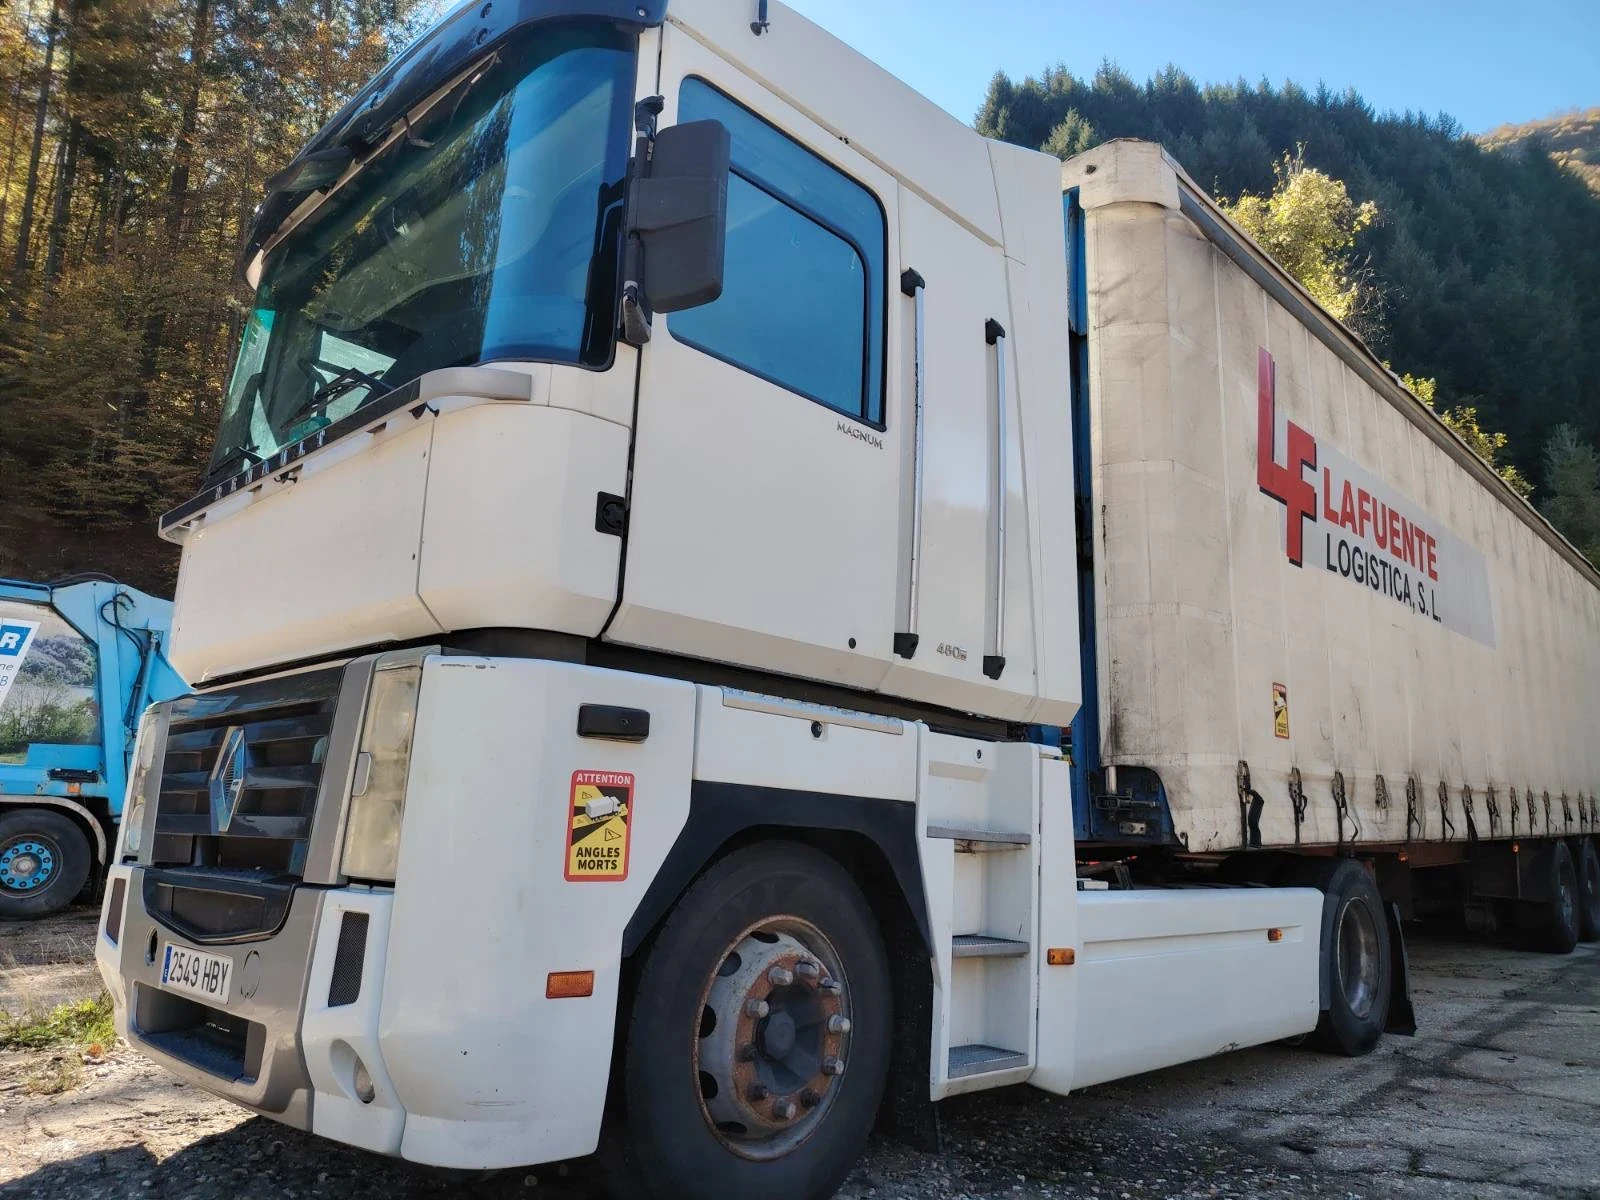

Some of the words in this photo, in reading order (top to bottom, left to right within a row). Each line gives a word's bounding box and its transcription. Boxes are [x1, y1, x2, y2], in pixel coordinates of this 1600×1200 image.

[836, 420, 885, 450] MAGNUM
[1323, 466, 1438, 582] LAFUENTE
[1326, 532, 1415, 614] LOGISTICA,
[1418, 581, 1430, 616] S.
[1431, 589, 1442, 623] L.
[576, 773, 631, 785] ATTENTION
[576, 847, 620, 858] ANGLES
[577, 859, 618, 870] MORTS
[169, 951, 200, 988] 2549
[201, 958, 229, 996] HBY
